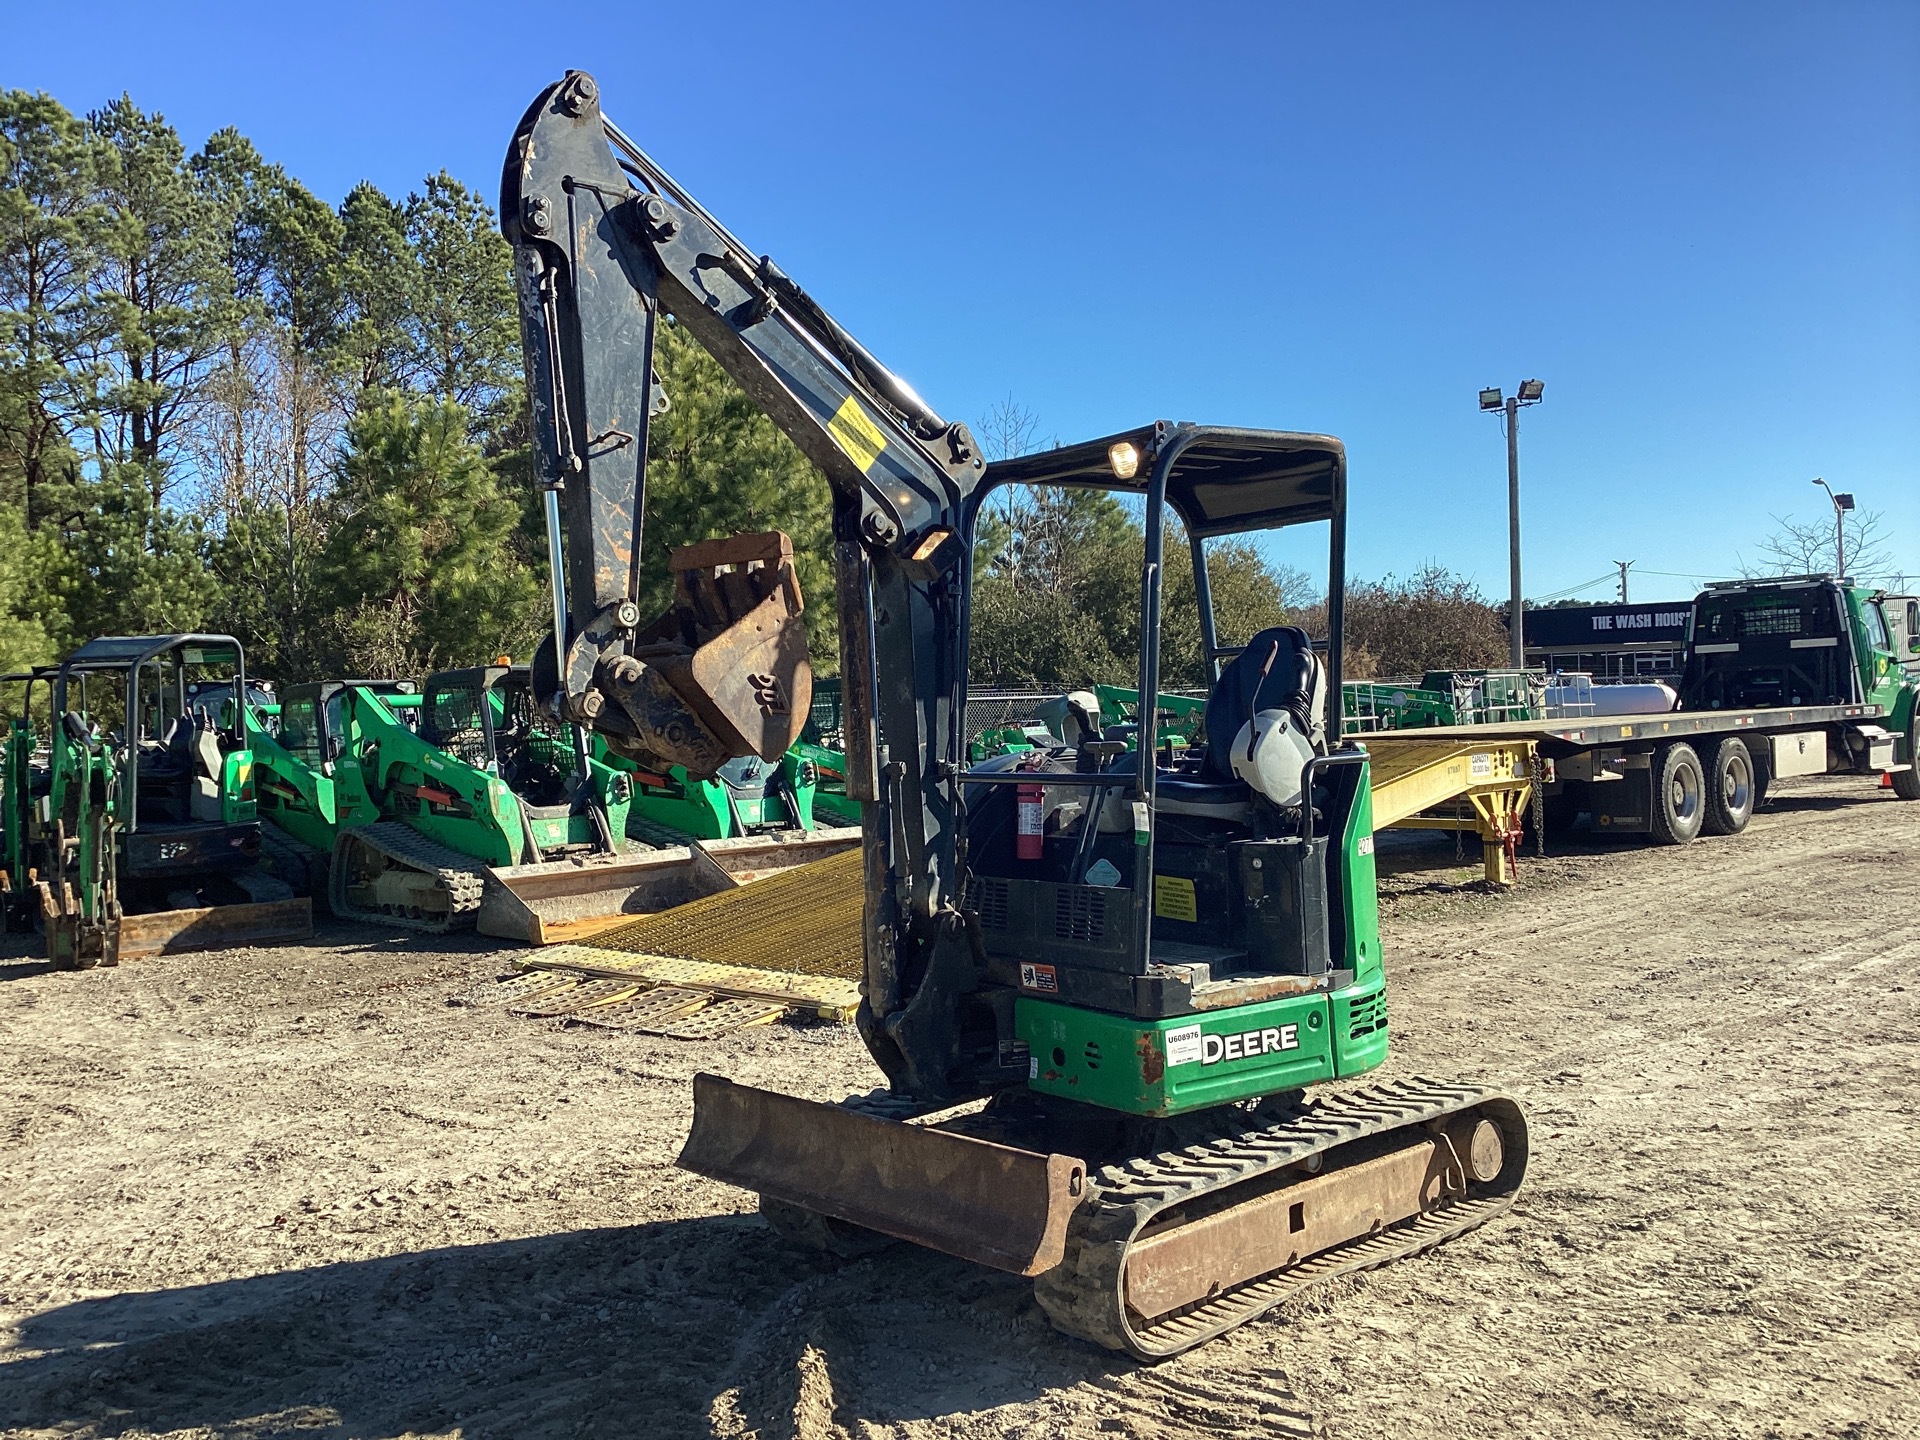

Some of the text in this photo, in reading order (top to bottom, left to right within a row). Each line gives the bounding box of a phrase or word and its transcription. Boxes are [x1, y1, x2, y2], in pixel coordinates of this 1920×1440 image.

[1591, 615, 1613, 630] THE
[1615, 613, 1652, 629] WASH
[1472, 755, 1489, 764] CAPACITY
[1168, 1031, 1199, 1044] U608976
[1201, 1024, 1299, 1065] DEERE
